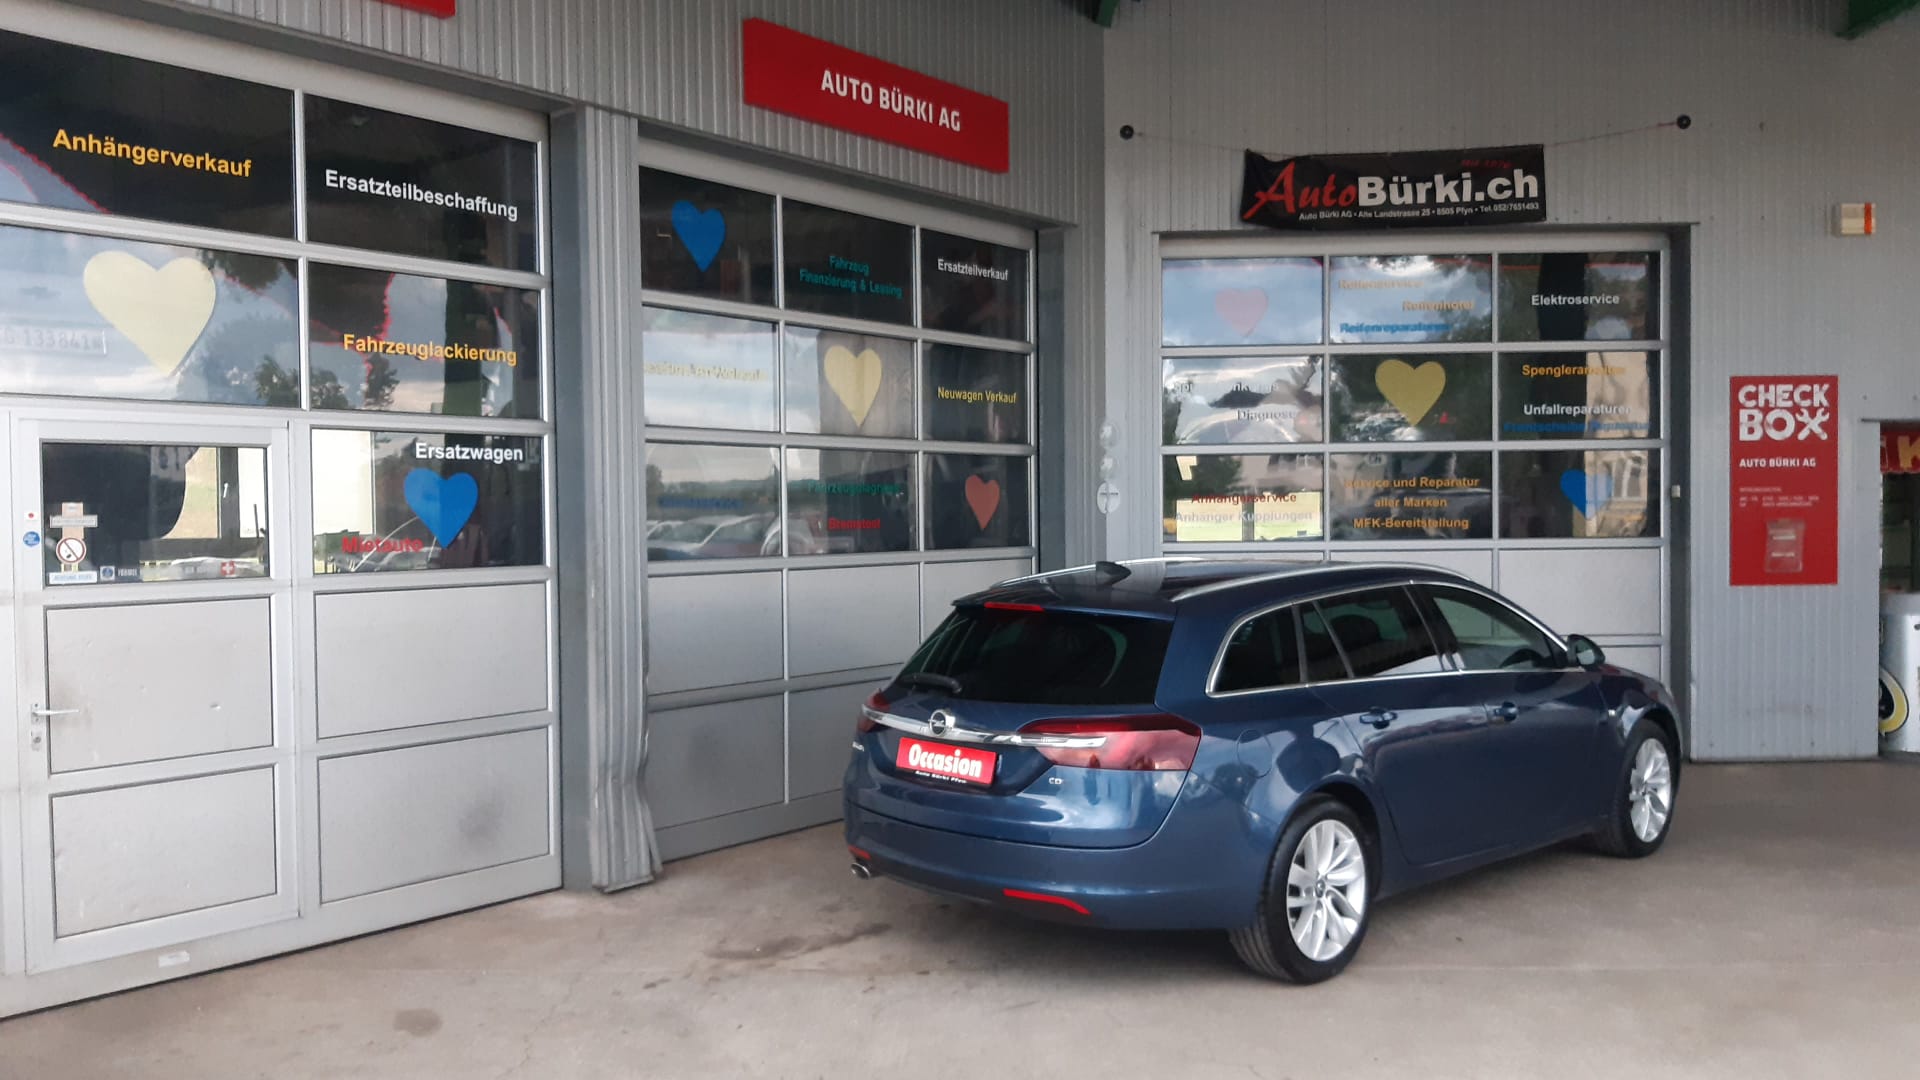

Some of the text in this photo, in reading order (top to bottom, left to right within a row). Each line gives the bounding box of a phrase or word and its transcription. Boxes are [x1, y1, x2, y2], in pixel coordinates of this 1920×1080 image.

[821, 69, 961, 132] AUTO BÜRKI AG
[53, 128, 252, 177] Anhängerverkauf
[325, 169, 518, 222] Ersatzteilbeschaffung
[1319, 210, 1340, 219] Bürki
[1358, 210, 1373, 218] Alte
[1374, 208, 1420, 218] Landstrasse
[1421, 208, 1431, 216] 25
[1437, 207, 1455, 215] 8505
[1456, 206, 1474, 216] Pfyn
[828, 255, 870, 276] Fahrzeug
[937, 258, 1009, 281] Ersatzteilverkauf
[800, 269, 904, 299] Finanzierung & Leasing
[1531, 293, 1620, 306] Elektroservice
[343, 334, 517, 366] Fahrzeuglackierung
[938, 386, 1017, 404] Neuwagen Verkauf
[1738, 384, 1830, 408] CHECK
[1739, 408, 1830, 441] BOX
[415, 442, 524, 464] Ersatzwagen
[1739, 457, 1816, 467] AUTO BÜRKI AG
[1393, 477, 1416, 487] und
[1420, 476, 1480, 489] Reparatur
[1374, 496, 1448, 508] aller Marken
[1353, 517, 1470, 530] MFK-Bereitstellung
[342, 536, 424, 553] Mietauto
[908, 743, 983, 778] Occasion
